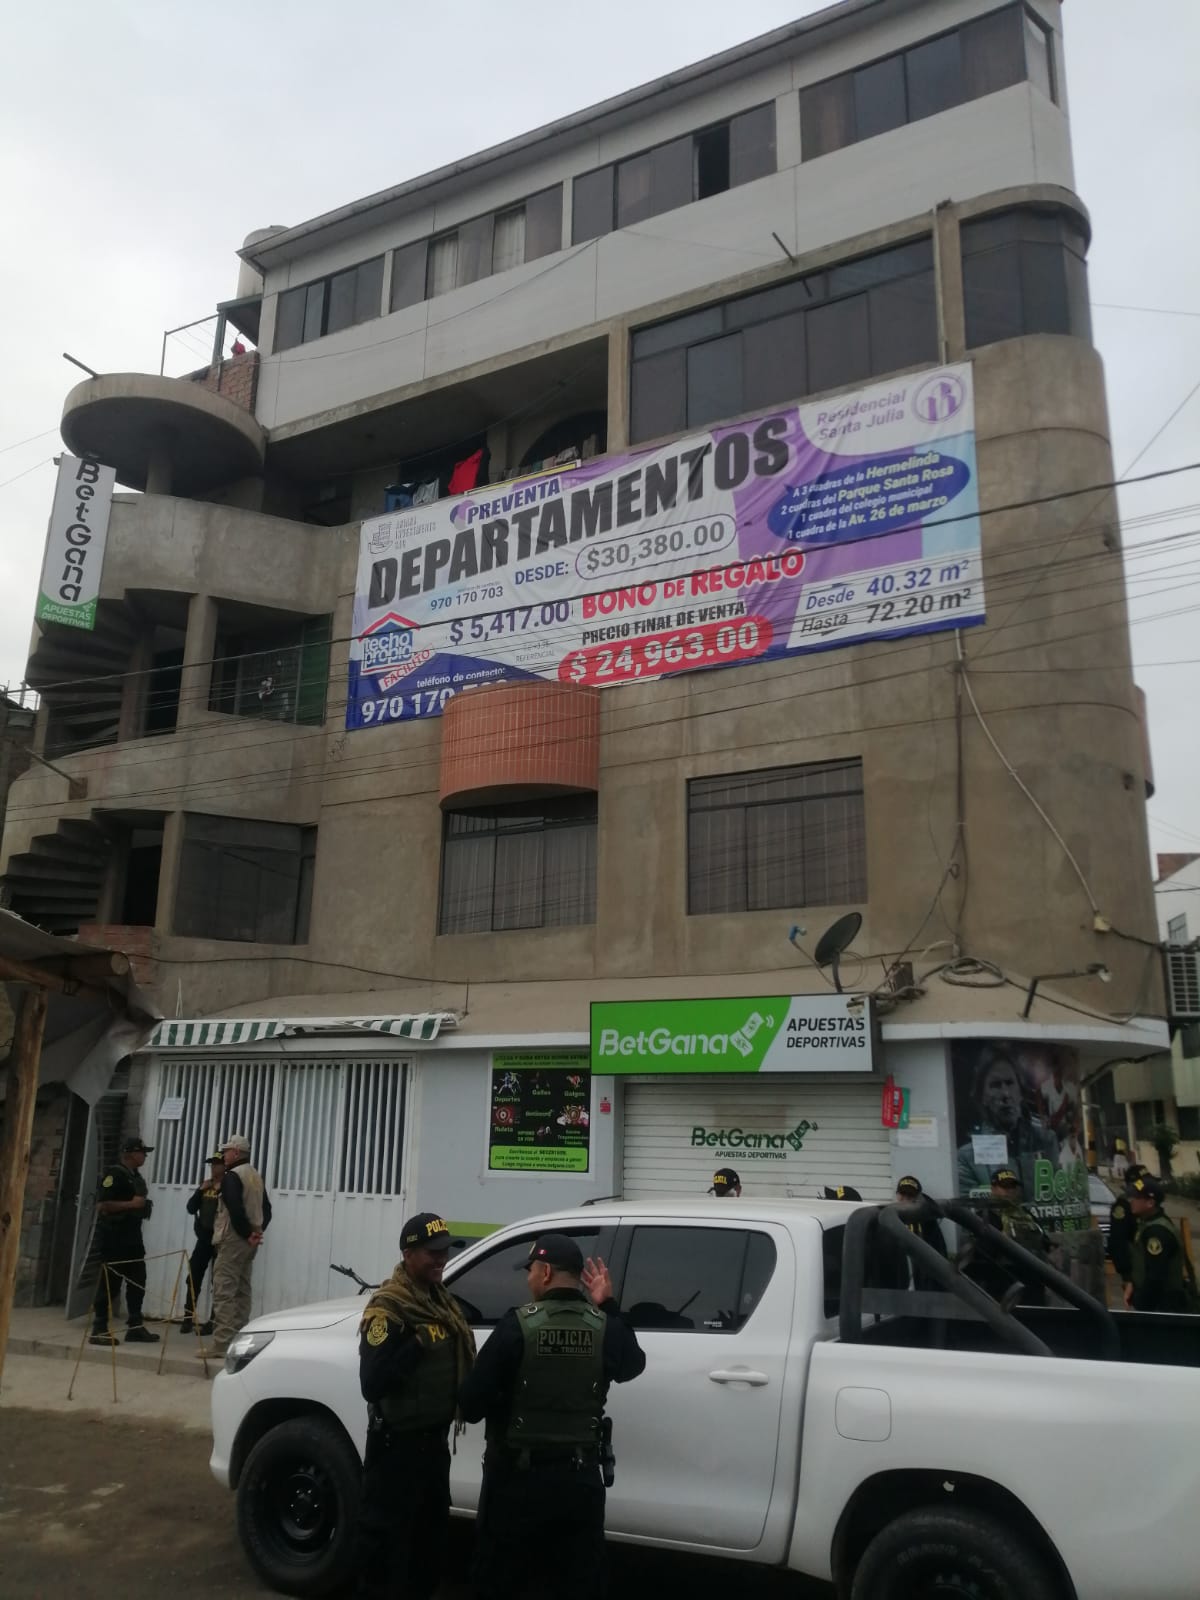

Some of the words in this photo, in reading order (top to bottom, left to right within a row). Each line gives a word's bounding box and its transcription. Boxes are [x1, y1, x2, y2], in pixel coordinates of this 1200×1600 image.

[817, 389, 907, 426] Residencial
[819, 420, 861, 440] Santa
[866, 410, 905, 428] Julia
[781, 505, 788, 516] 2
[788, 496, 821, 513] cuadras
[822, 493, 837, 505] del
[838, 485, 880, 502] Parque
[883, 473, 919, 491] Santa
[922, 465, 954, 482] Rosa
[792, 487, 800, 498] A
[801, 486, 808, 496] 3
[809, 479, 842, 493] cuadras
[843, 475, 855, 485] de
[855, 472, 865, 482] la
[866, 451, 940, 479] Hermelinda
[367, 416, 791, 610] DEPARTAMENTOS
[467, 477, 561, 524] PREVENTA
[808, 505, 837, 521] cuadra
[838, 502, 852, 513] del
[853, 494, 887, 510] colegio
[888, 484, 933, 502] municipal
[59, 459, 100, 602] BetGana
[796, 523, 825, 539] cuadra
[826, 521, 837, 532] de
[837, 519, 847, 530] la
[848, 514, 866, 527] Av.
[870, 508, 886, 521] 26
[889, 503, 904, 516] de
[907, 496, 948, 513] marzo
[515, 561, 569, 585] DESDE:
[586, 519, 725, 572] $30,380.00
[430, 596, 452, 611] 970
[456, 591, 477, 606] 170
[481, 585, 504, 600] 703
[449, 618, 464, 646] $
[470, 600, 570, 641] 5,417.00
[582, 580, 657, 619] BONO
[663, 578, 685, 599] DE
[690, 548, 806, 597] REGALO
[805, 587, 855, 611] Desde
[866, 567, 932, 597] 40.32
[939, 559, 970, 583] m²
[43, 603, 92, 622] APUESTAS
[582, 622, 630, 646] PRECIO
[633, 613, 673, 636] FINAL
[676, 610, 695, 627] DE
[699, 601, 745, 623] VENTA
[801, 614, 849, 633] Hasta
[866, 595, 934, 624] 72.20
[364, 631, 410, 650] techo
[364, 644, 413, 668] propio
[569, 653, 588, 683] $
[595, 621, 759, 677] 24,963.00
[417, 674, 451, 689] teléfono
[452, 672, 464, 683] de
[466, 667, 506, 680] contacto:
[361, 696, 404, 723] 970
[786, 1016, 866, 1032] APUESTAS
[598, 1028, 729, 1056] BetGana
[786, 1036, 866, 1049] DEPORTIVAS
[691, 1127, 788, 1149] BetGana
[715, 1151, 747, 1159] APUESTAS
[747, 1152, 787, 1160] DEPORTIVAS
[539, 1330, 592, 1346] POLICIA
